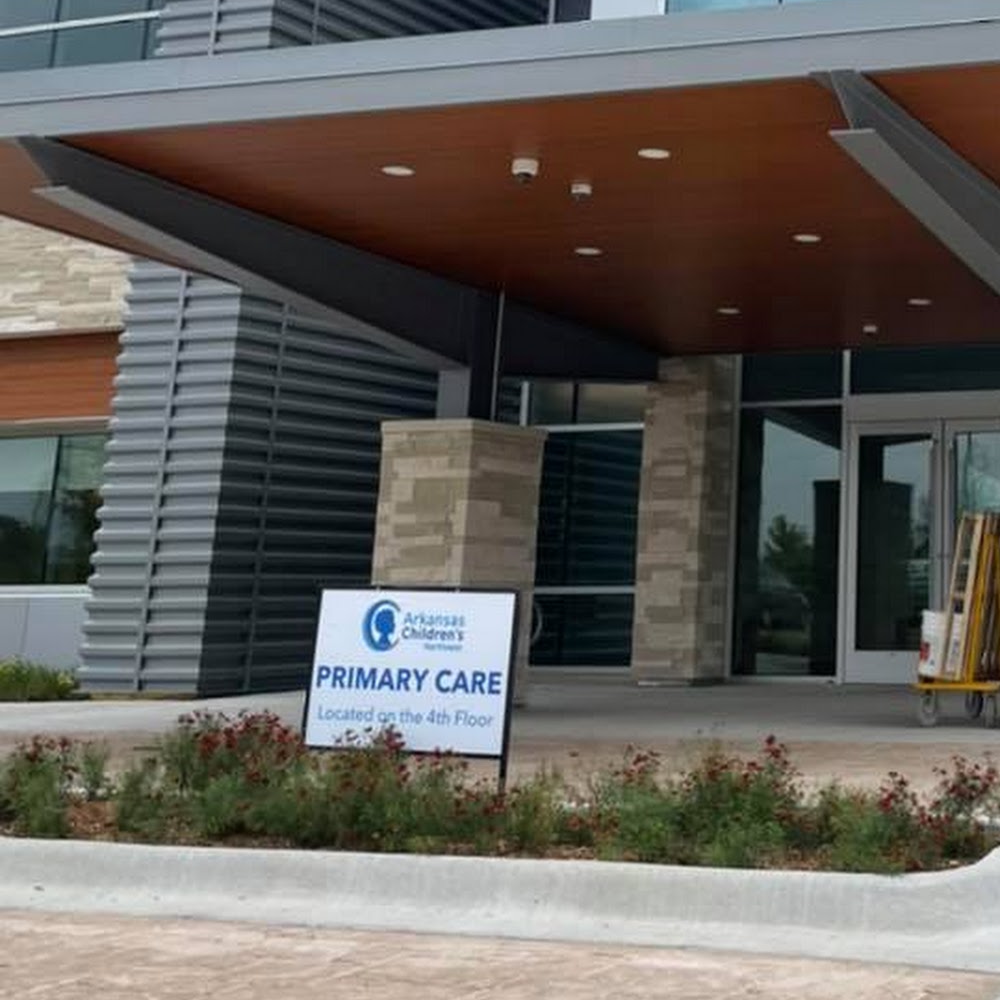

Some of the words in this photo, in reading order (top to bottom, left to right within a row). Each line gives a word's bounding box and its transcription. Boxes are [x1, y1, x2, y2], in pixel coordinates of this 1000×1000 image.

[403, 612, 466, 627] Arkansas
[401, 627, 464, 641] Children's
[316, 666, 429, 692] PRIMARY
[435, 669, 502, 695] CARE
[317, 706, 374, 722] Located
[378, 711, 394, 724] on
[399, 709, 423, 724] the
[426, 710, 451, 726] 4th
[454, 711, 493, 728] Floor
